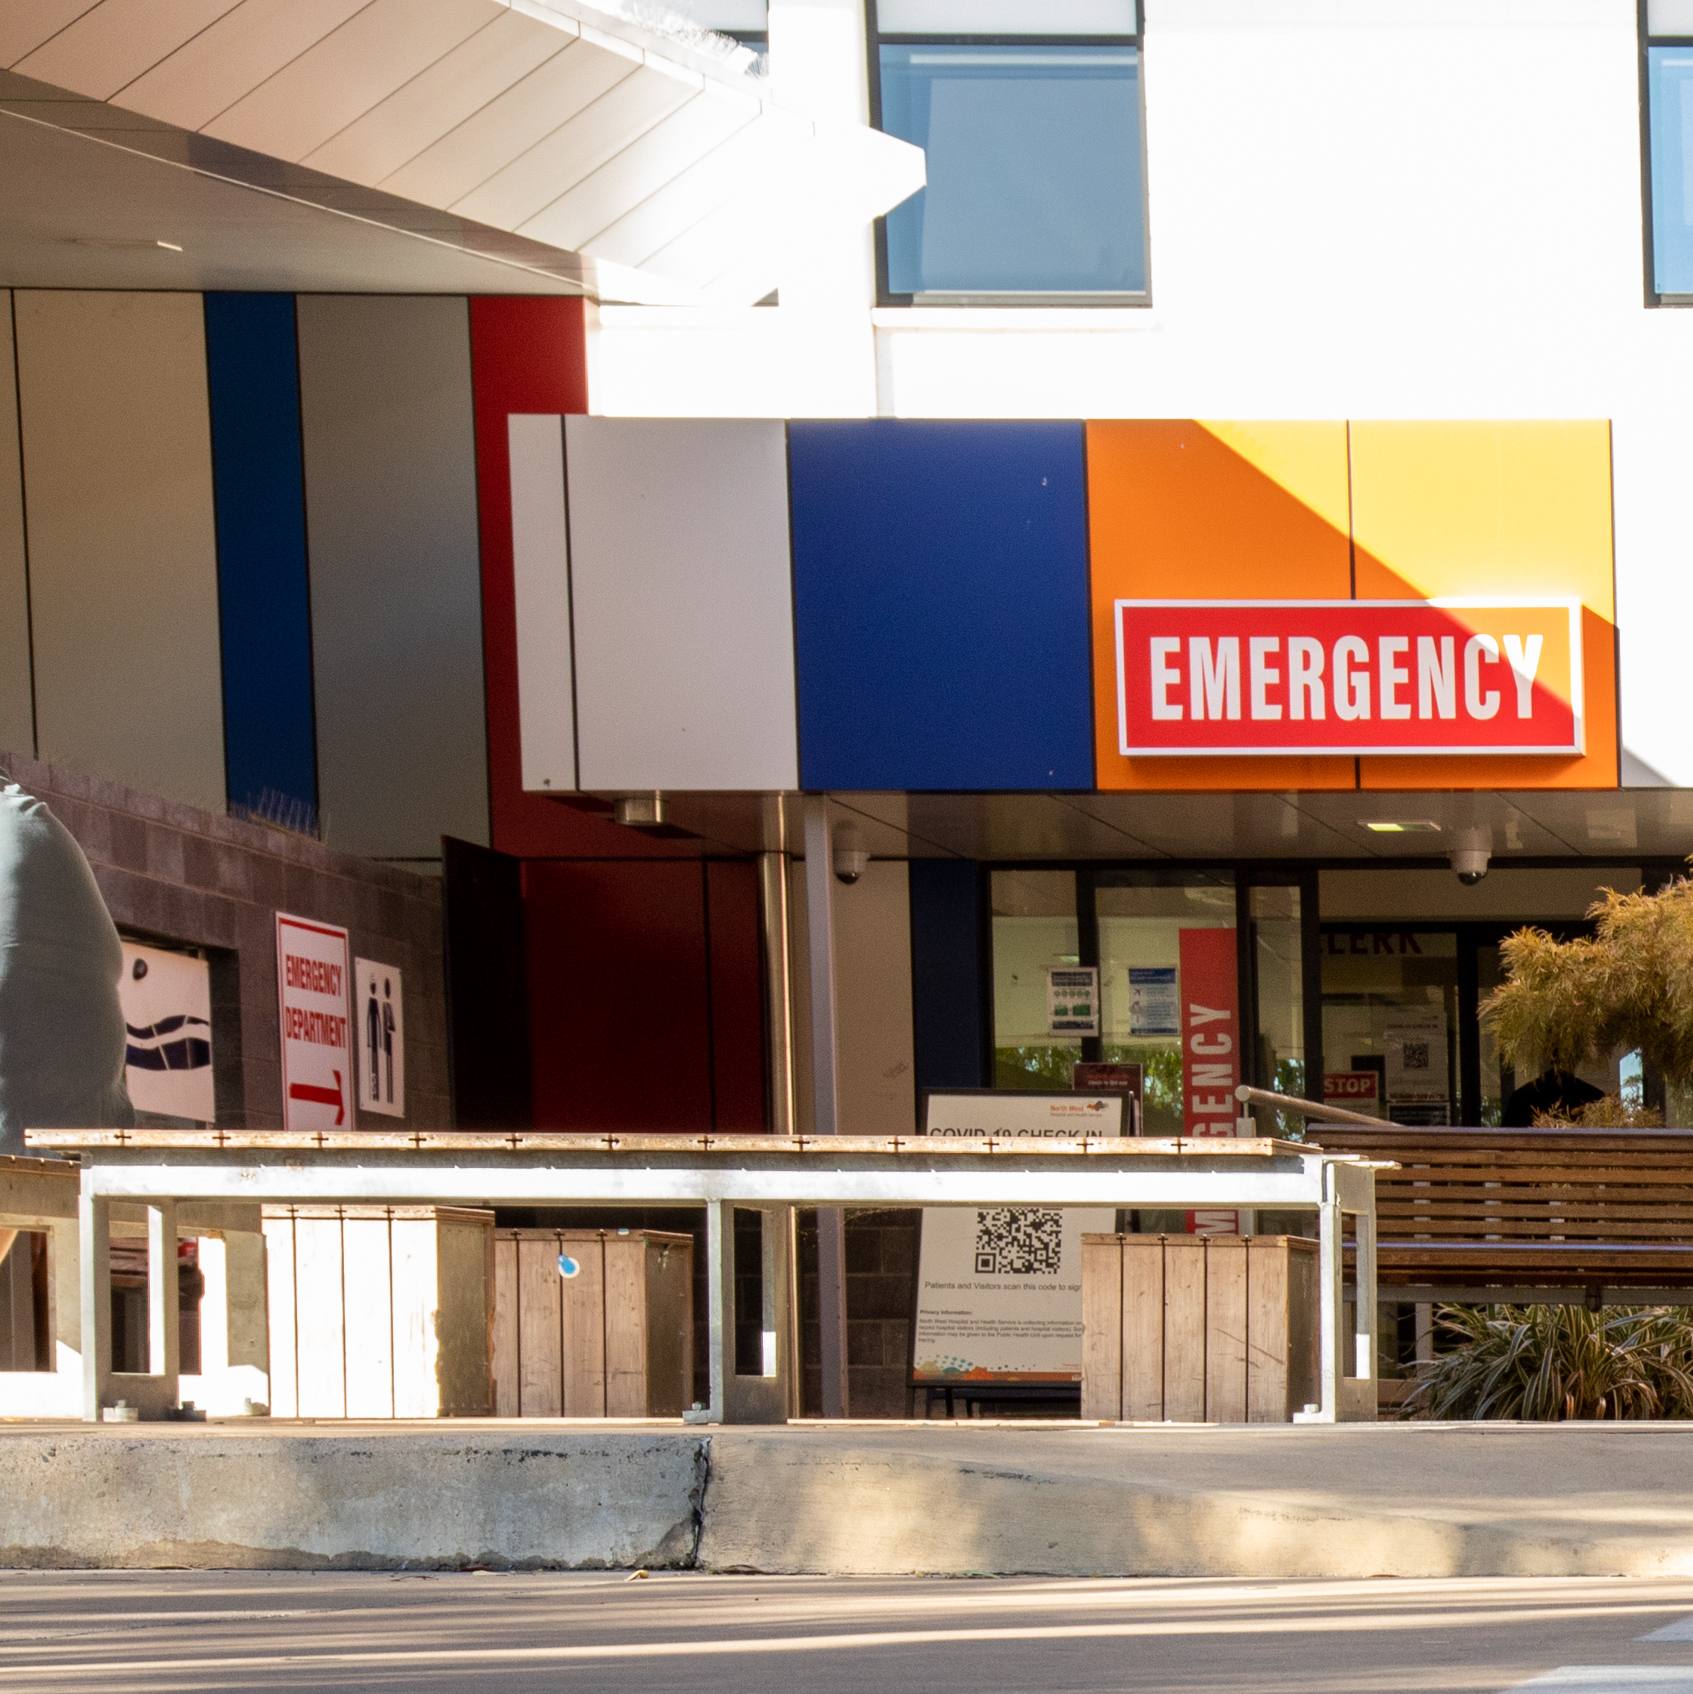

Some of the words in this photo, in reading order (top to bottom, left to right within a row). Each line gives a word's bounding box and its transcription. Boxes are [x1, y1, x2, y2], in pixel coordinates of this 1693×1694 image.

[1149, 634, 1544, 721] EMERGENCY
[1320, 933, 1422, 954] LERK
[286, 954, 342, 997] EMERGENCY
[285, 1006, 346, 1048] DEPARTMENT
[1324, 1078, 1371, 1093] STOP
[930, 1128, 1011, 1137] COVID19
[1017, 1129, 1080, 1137] CHECK
[957, 1282, 971, 1290] and
[974, 1282, 1000, 1290] Visitors
